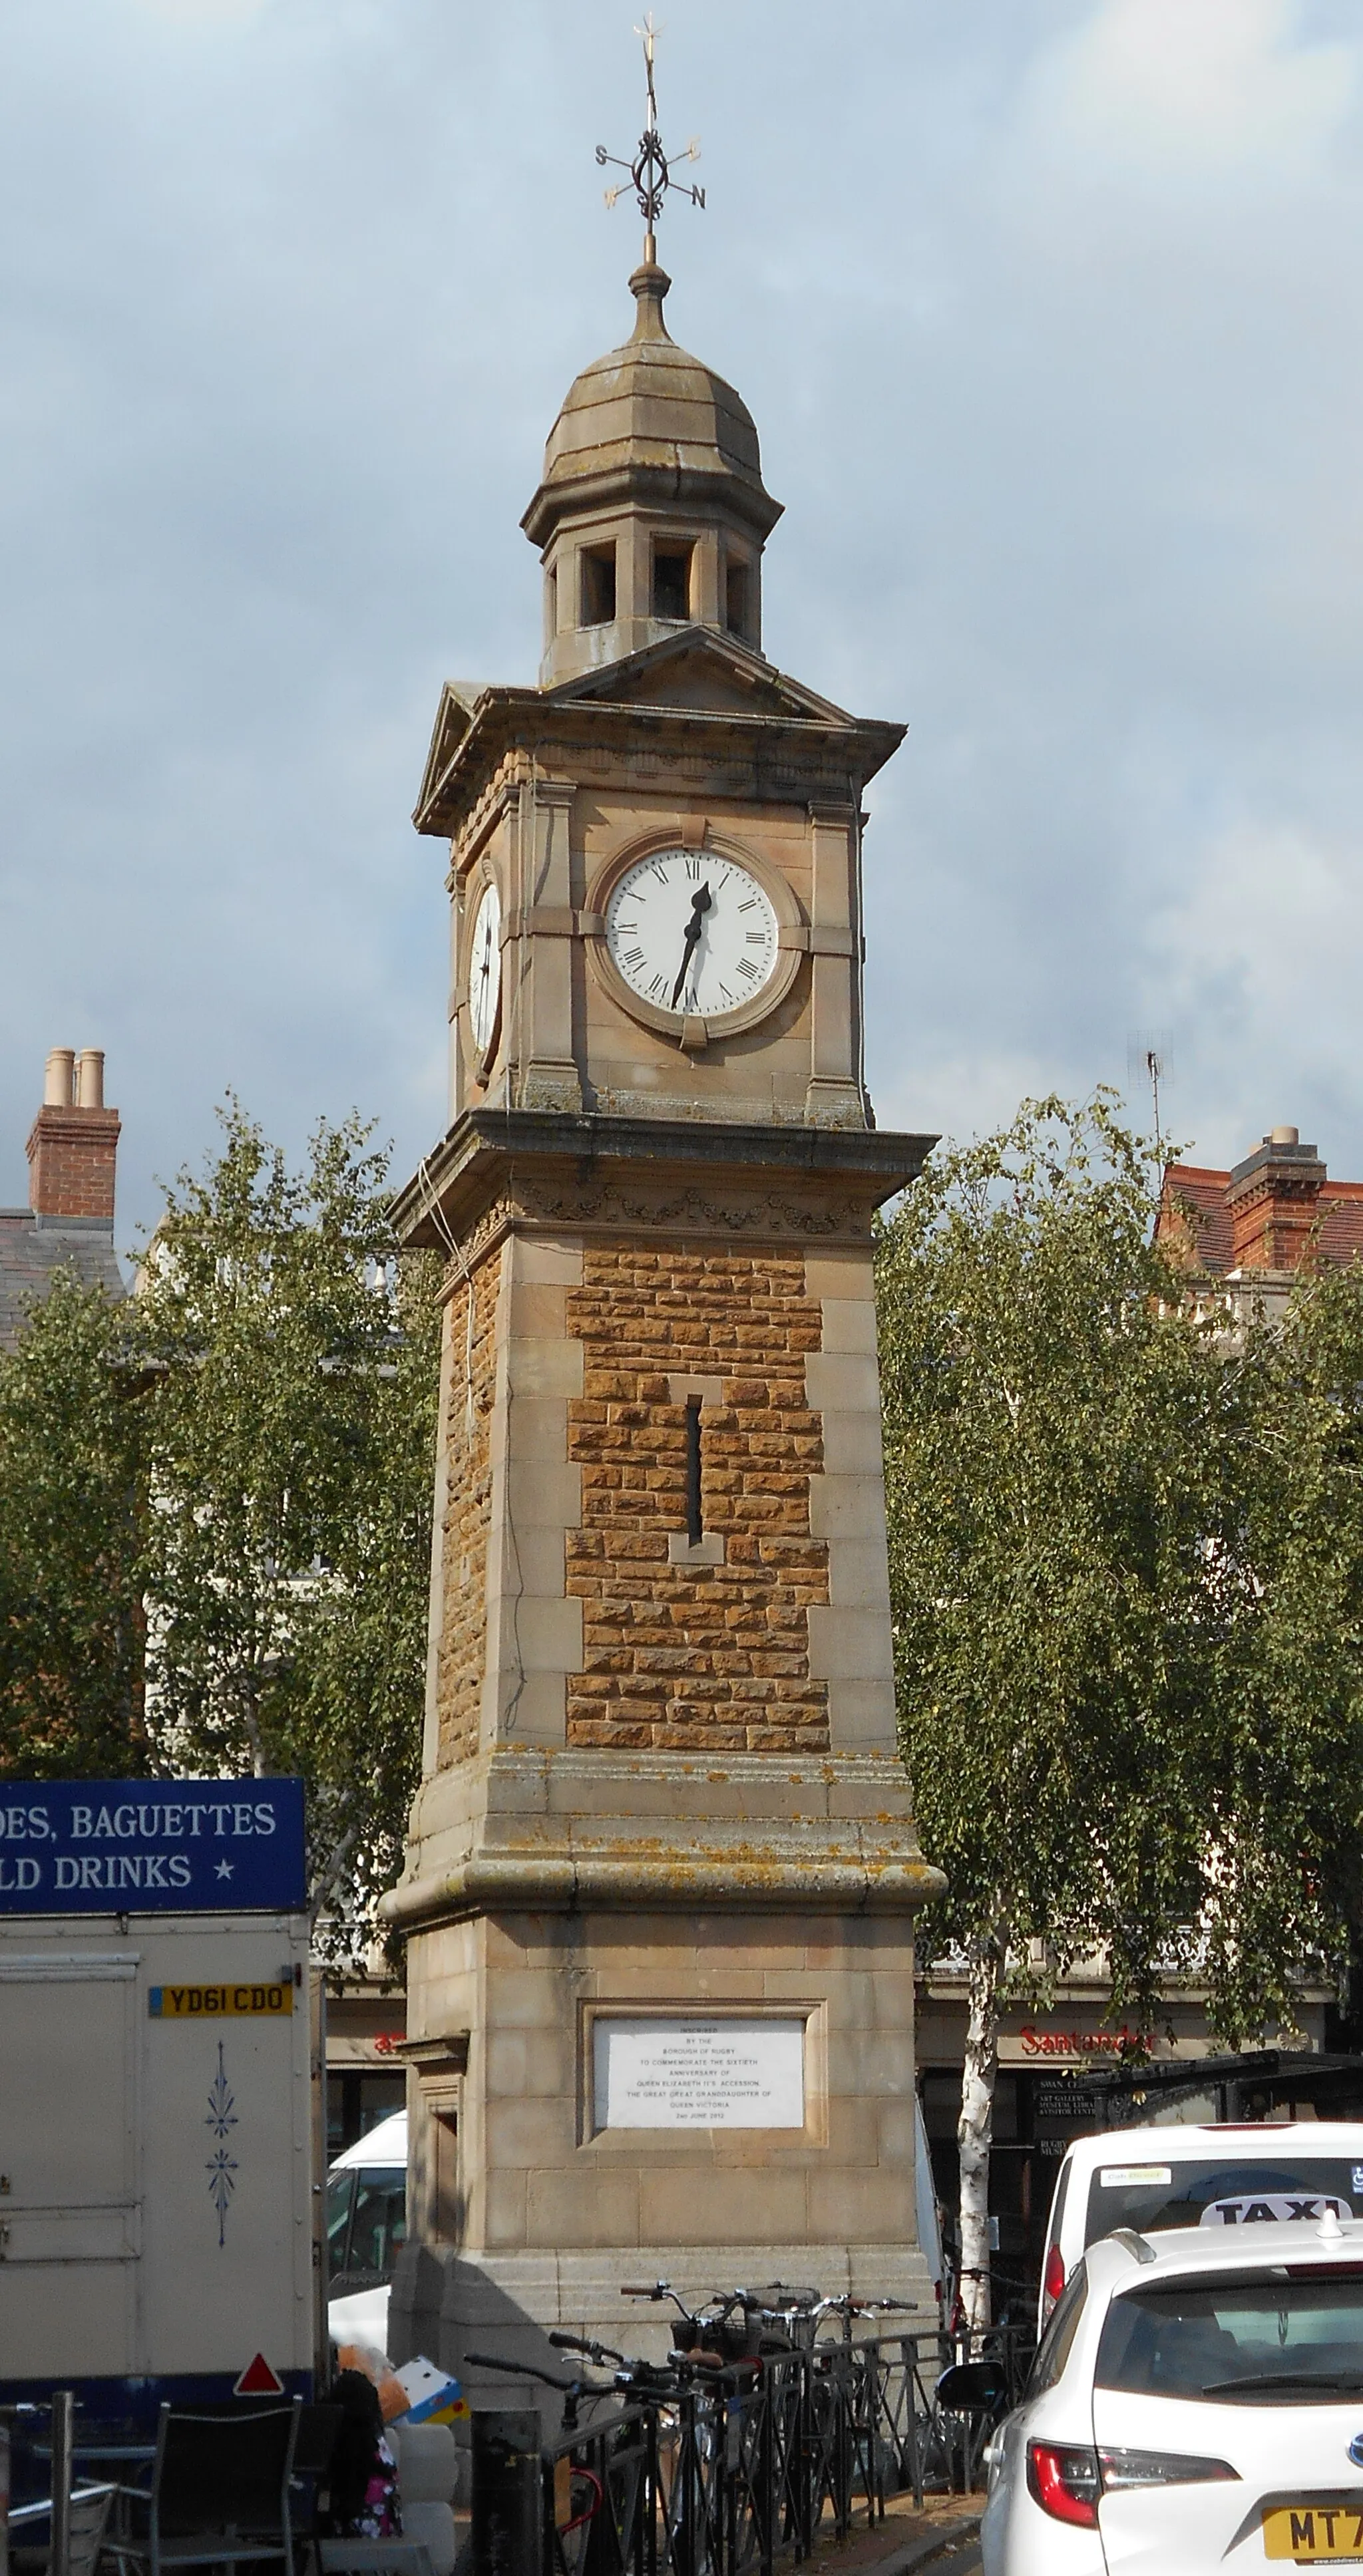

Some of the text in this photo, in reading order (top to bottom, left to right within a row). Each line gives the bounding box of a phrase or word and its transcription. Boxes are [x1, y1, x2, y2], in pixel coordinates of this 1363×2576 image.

[596, 145, 607, 166] S
[692, 184, 705, 210] N
[651, 865, 670, 886] XI
[685, 860, 699, 881] XII
[719, 872, 730, 889] I
[627, 890, 646, 904] X
[737, 899, 757, 913] II
[617, 922, 638, 935] IX
[745, 931, 765, 944] III
[623, 947, 648, 974] VIII
[735, 957, 759, 980] IIII
[648, 973, 670, 999] VII
[719, 982, 733, 1002] V
[685, 987, 699, 1007] VI
[0, 1804, 276, 1843] ES, BAGUETTES
[53, 1855, 191, 1889] DRINKS
[170, 1987, 283, 2012] YD61 CDO
[1216, 2200, 1340, 2225] TAXI
[1290, 2511, 1363, 2550] MT7
